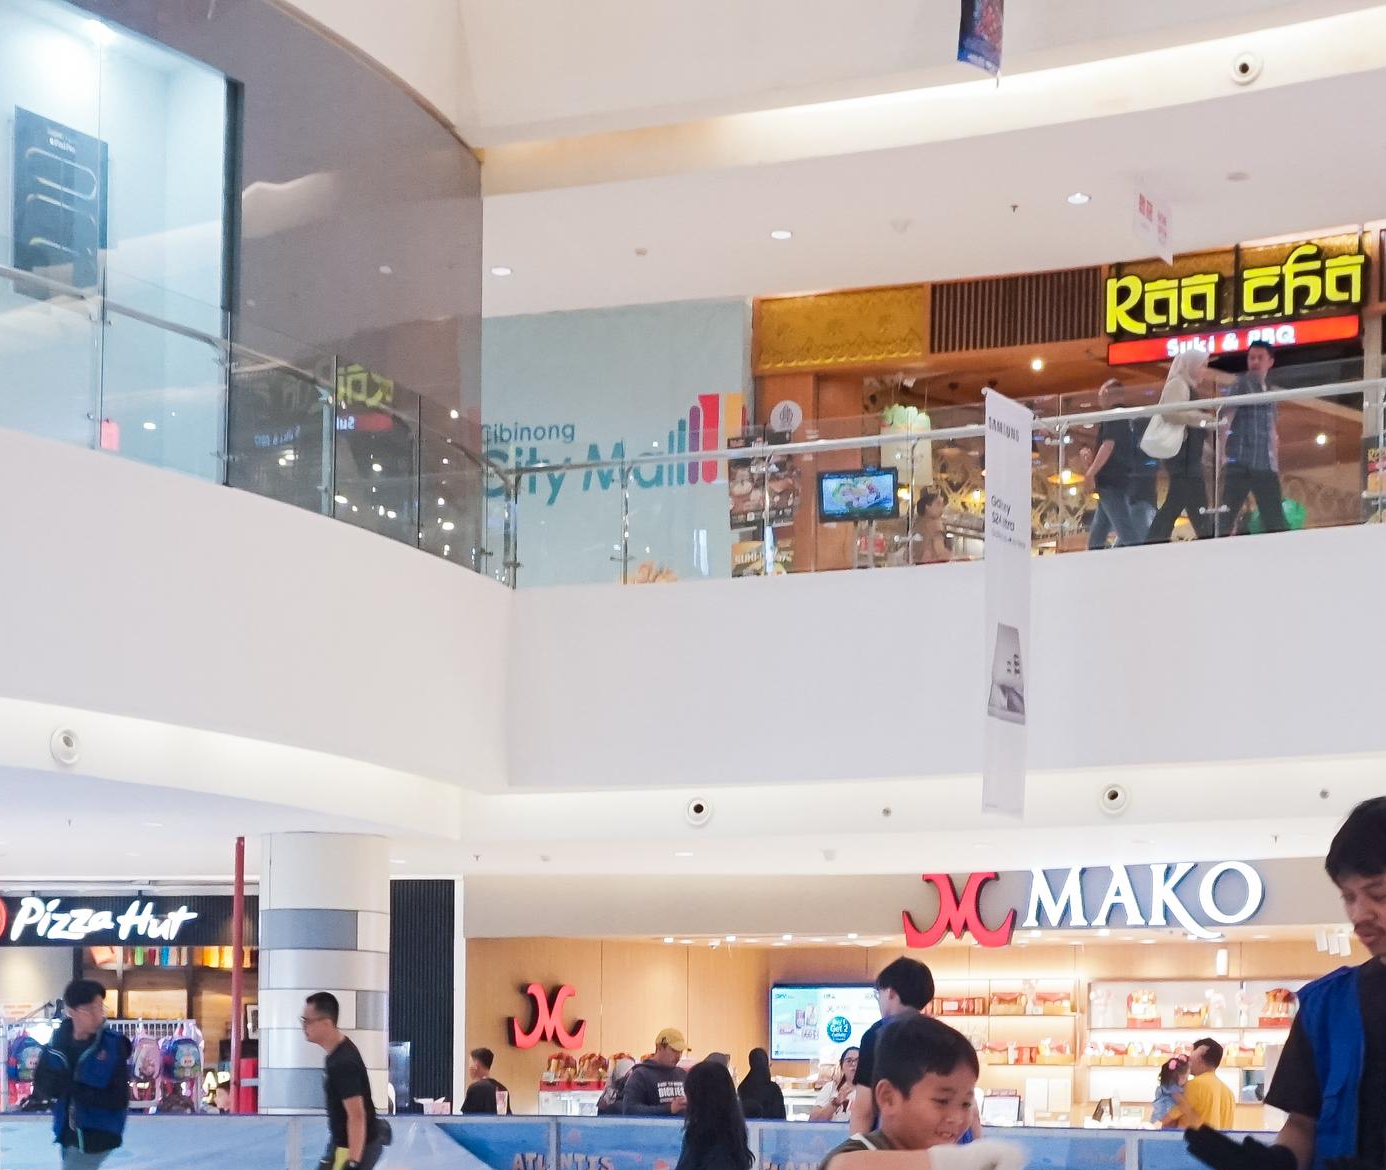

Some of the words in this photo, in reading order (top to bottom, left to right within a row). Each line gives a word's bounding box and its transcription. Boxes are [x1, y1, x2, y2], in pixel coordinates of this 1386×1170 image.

[1222, 332, 1239, 351] &
[10, 897, 114, 941] Pizza
[116, 900, 199, 940] Hut
[1022, 861, 1266, 939] MAKO
